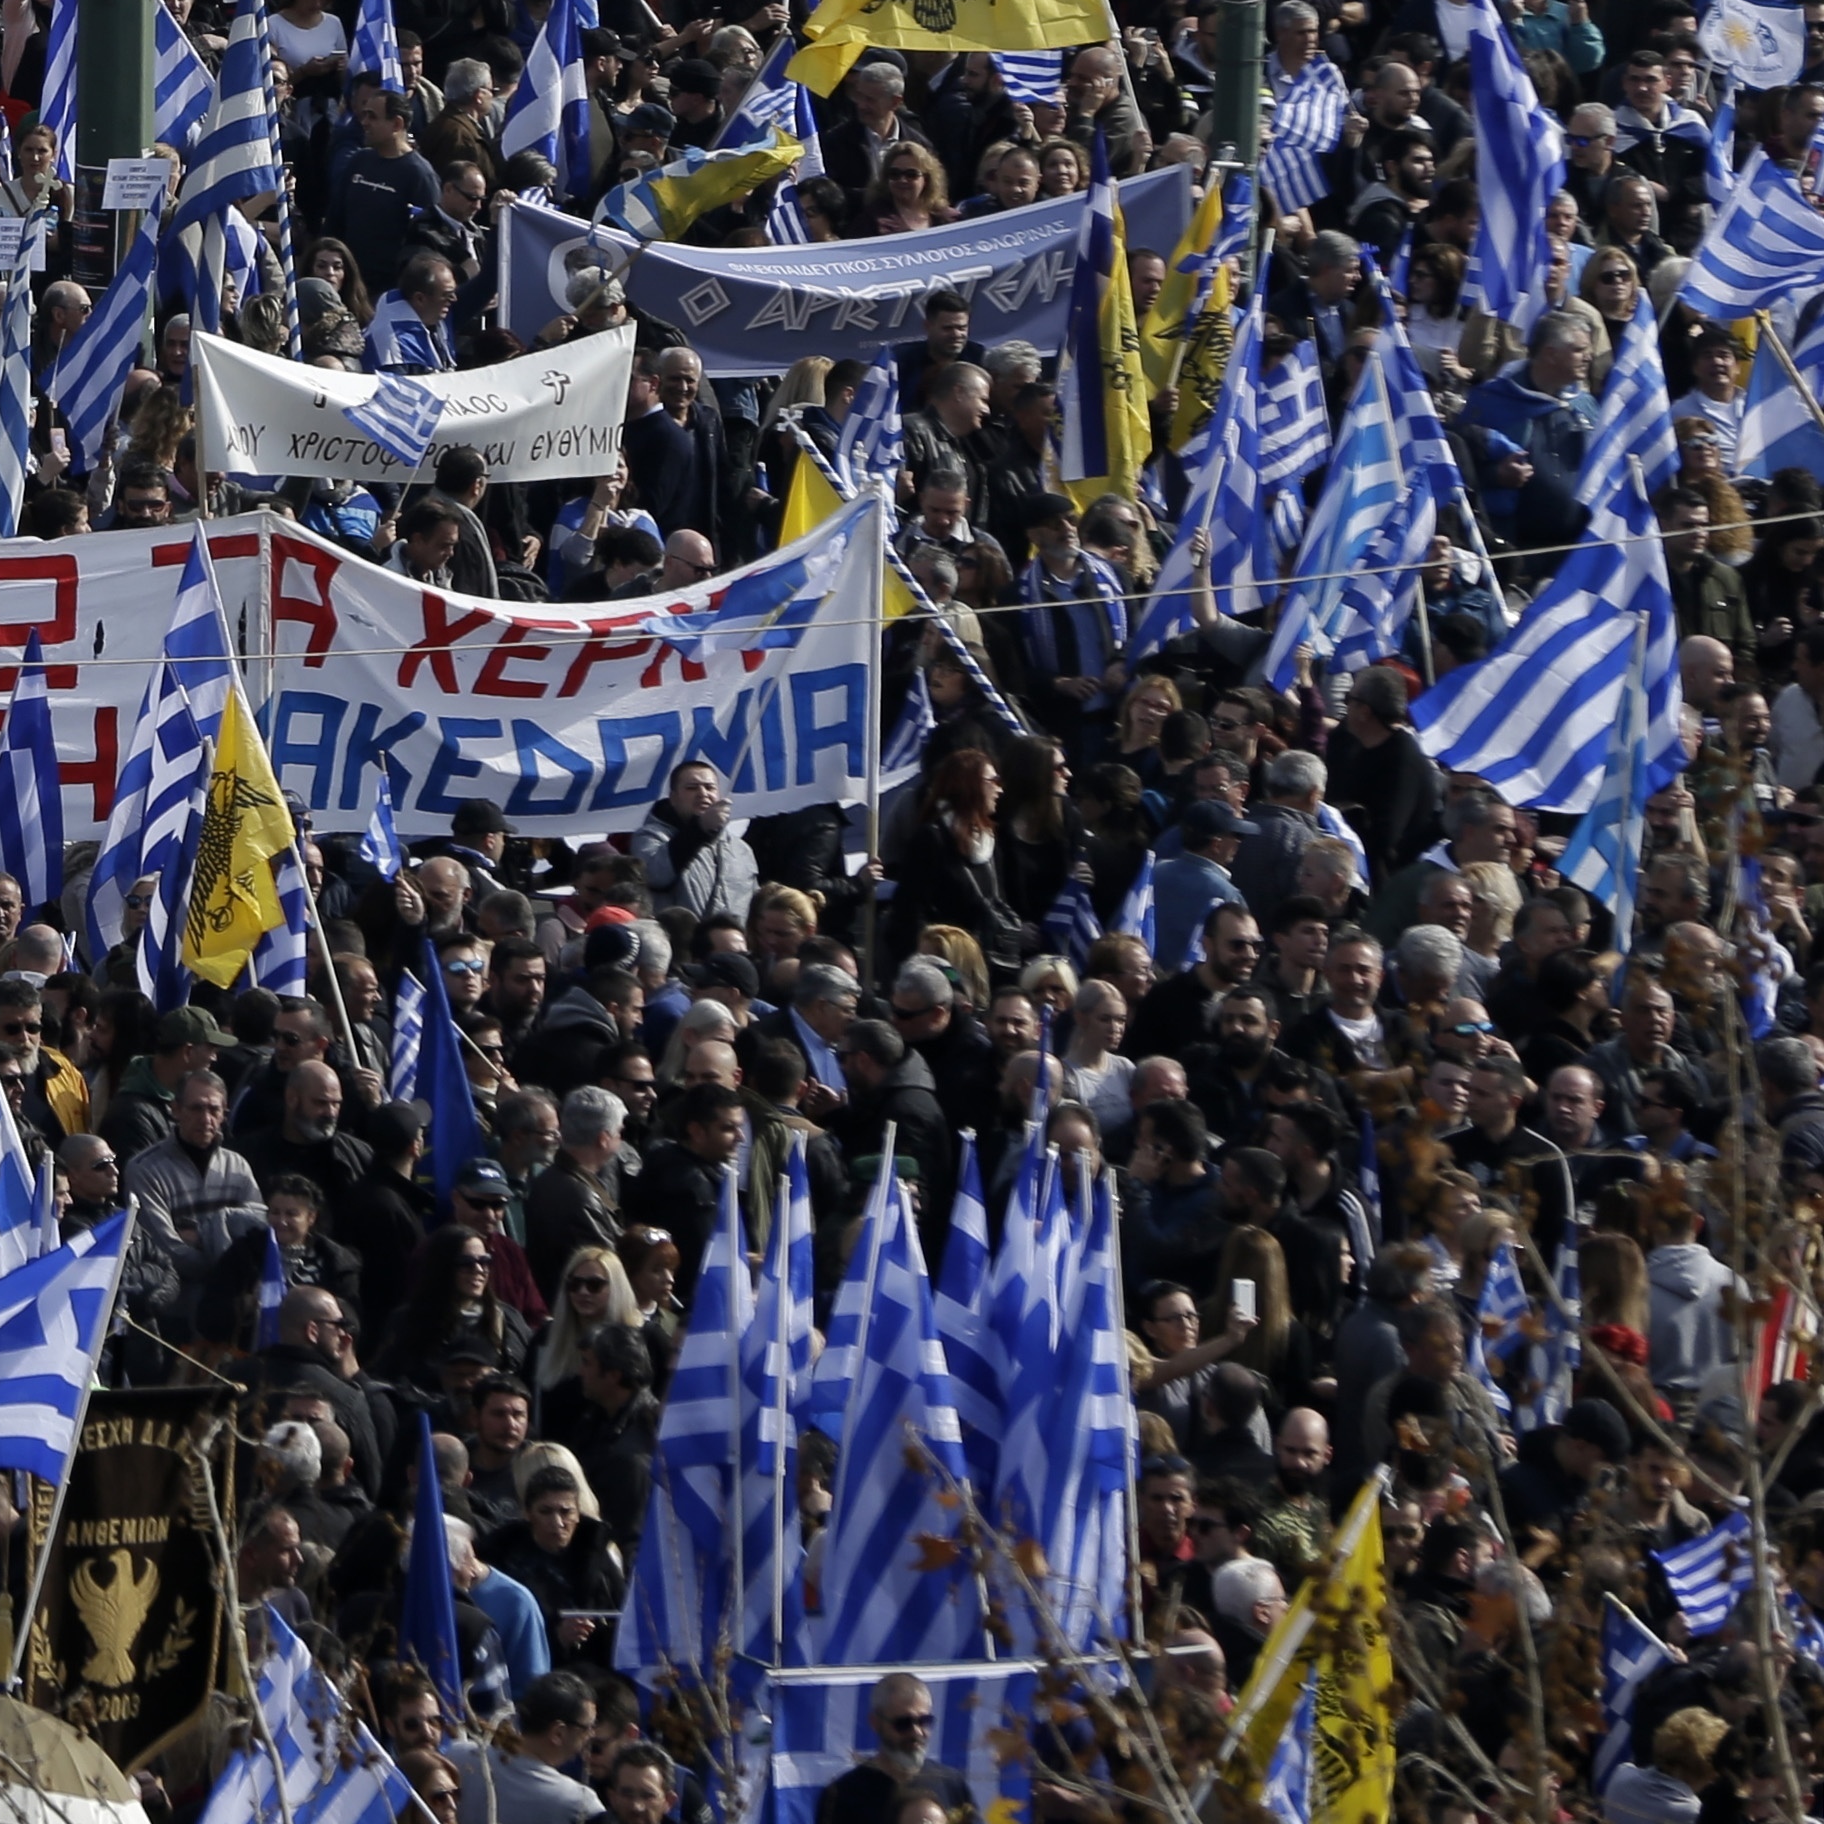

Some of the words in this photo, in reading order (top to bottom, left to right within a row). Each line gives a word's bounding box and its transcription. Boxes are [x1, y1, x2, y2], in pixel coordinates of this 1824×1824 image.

[881, 243, 977, 270] ΣΥΛΛΟΓΟΣ
[977, 219, 1072, 254] ΦΛΩΡΙΝΑΣ
[255, 663, 868, 816] ΑΚΕΔΟΝΙΑ
